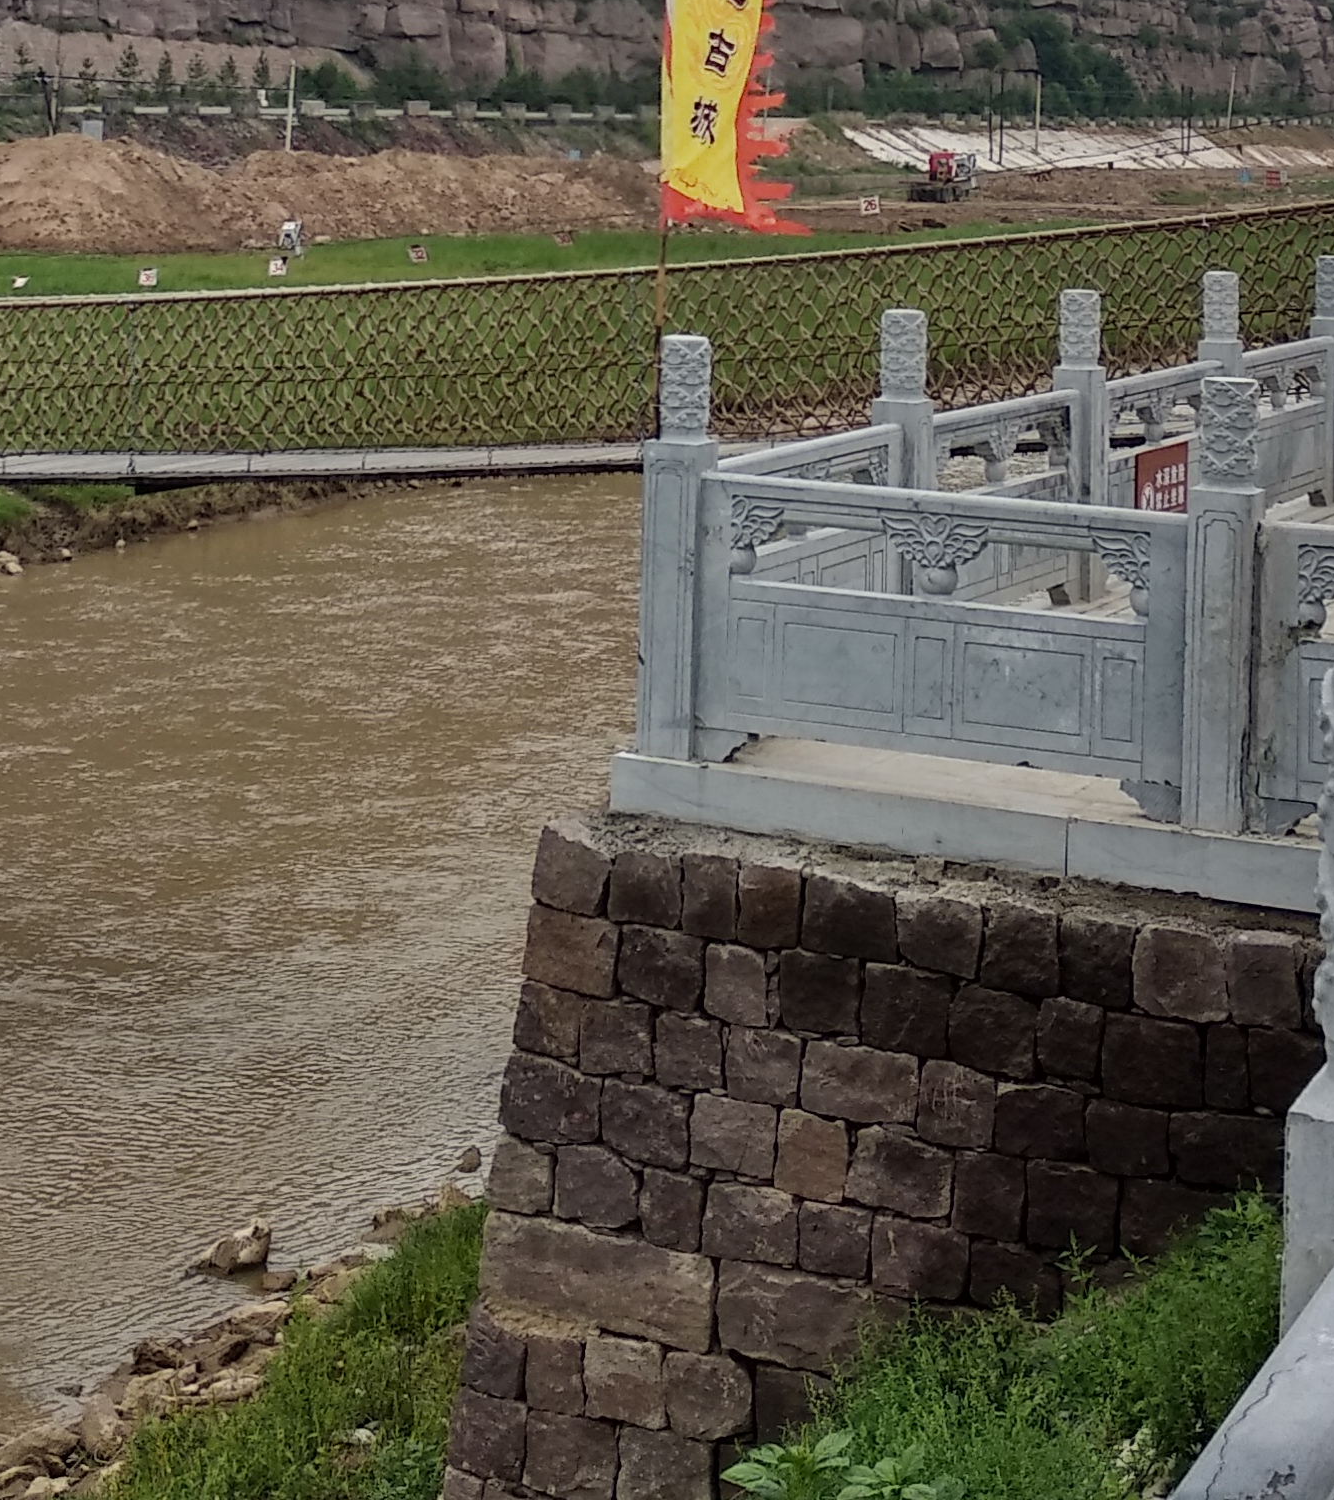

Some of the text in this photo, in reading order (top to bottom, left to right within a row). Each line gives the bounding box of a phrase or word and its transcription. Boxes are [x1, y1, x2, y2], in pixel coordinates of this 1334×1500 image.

[863, 199, 877, 211] 26
[1154, 463, 1186, 489] 水深危险
